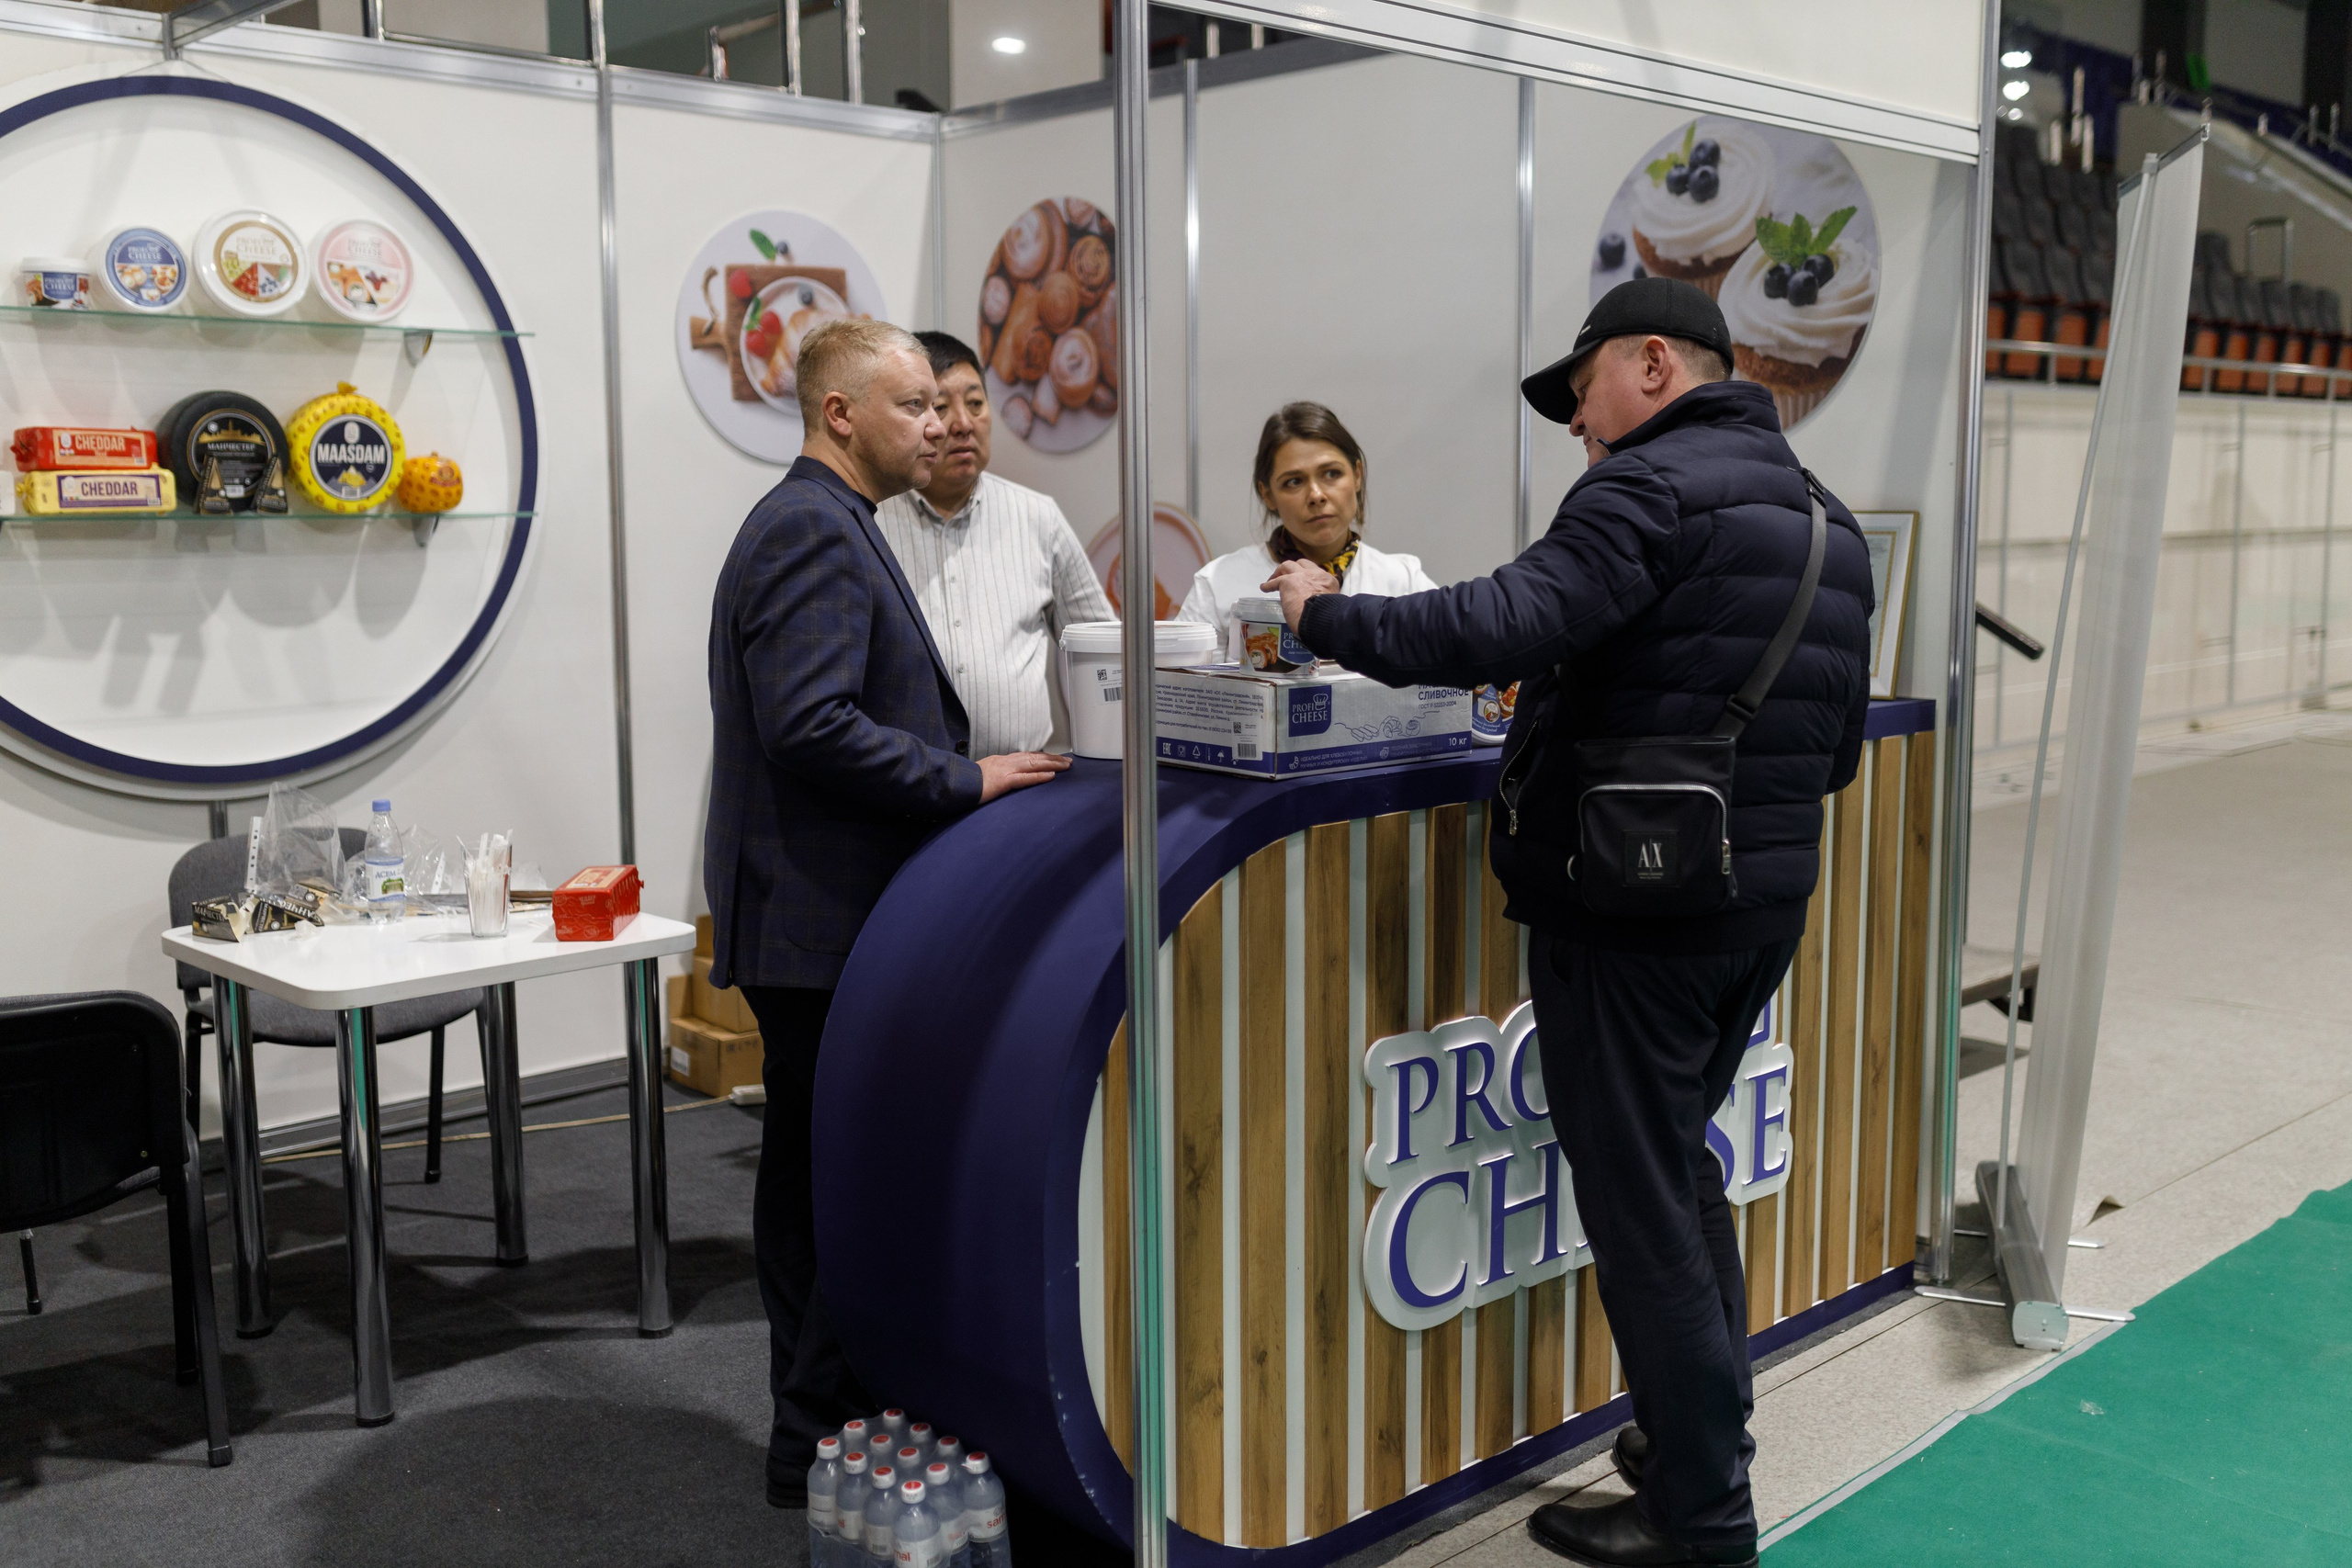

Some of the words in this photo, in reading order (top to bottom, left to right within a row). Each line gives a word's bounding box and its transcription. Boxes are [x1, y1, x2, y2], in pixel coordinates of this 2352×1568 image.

[75, 434, 125, 451] CHEDDAR
[317, 443, 385, 464] MAASDAM
[81, 481, 138, 496] CHEDDAR
[1418, 688, 1469, 700] СЛИВОЧНОЕ
[1292, 703, 1314, 712] PROFI
[1292, 711, 1328, 723] CHEESE
[1448, 738, 1457, 746] 10
[1387, 1026, 1553, 1165] PRO
